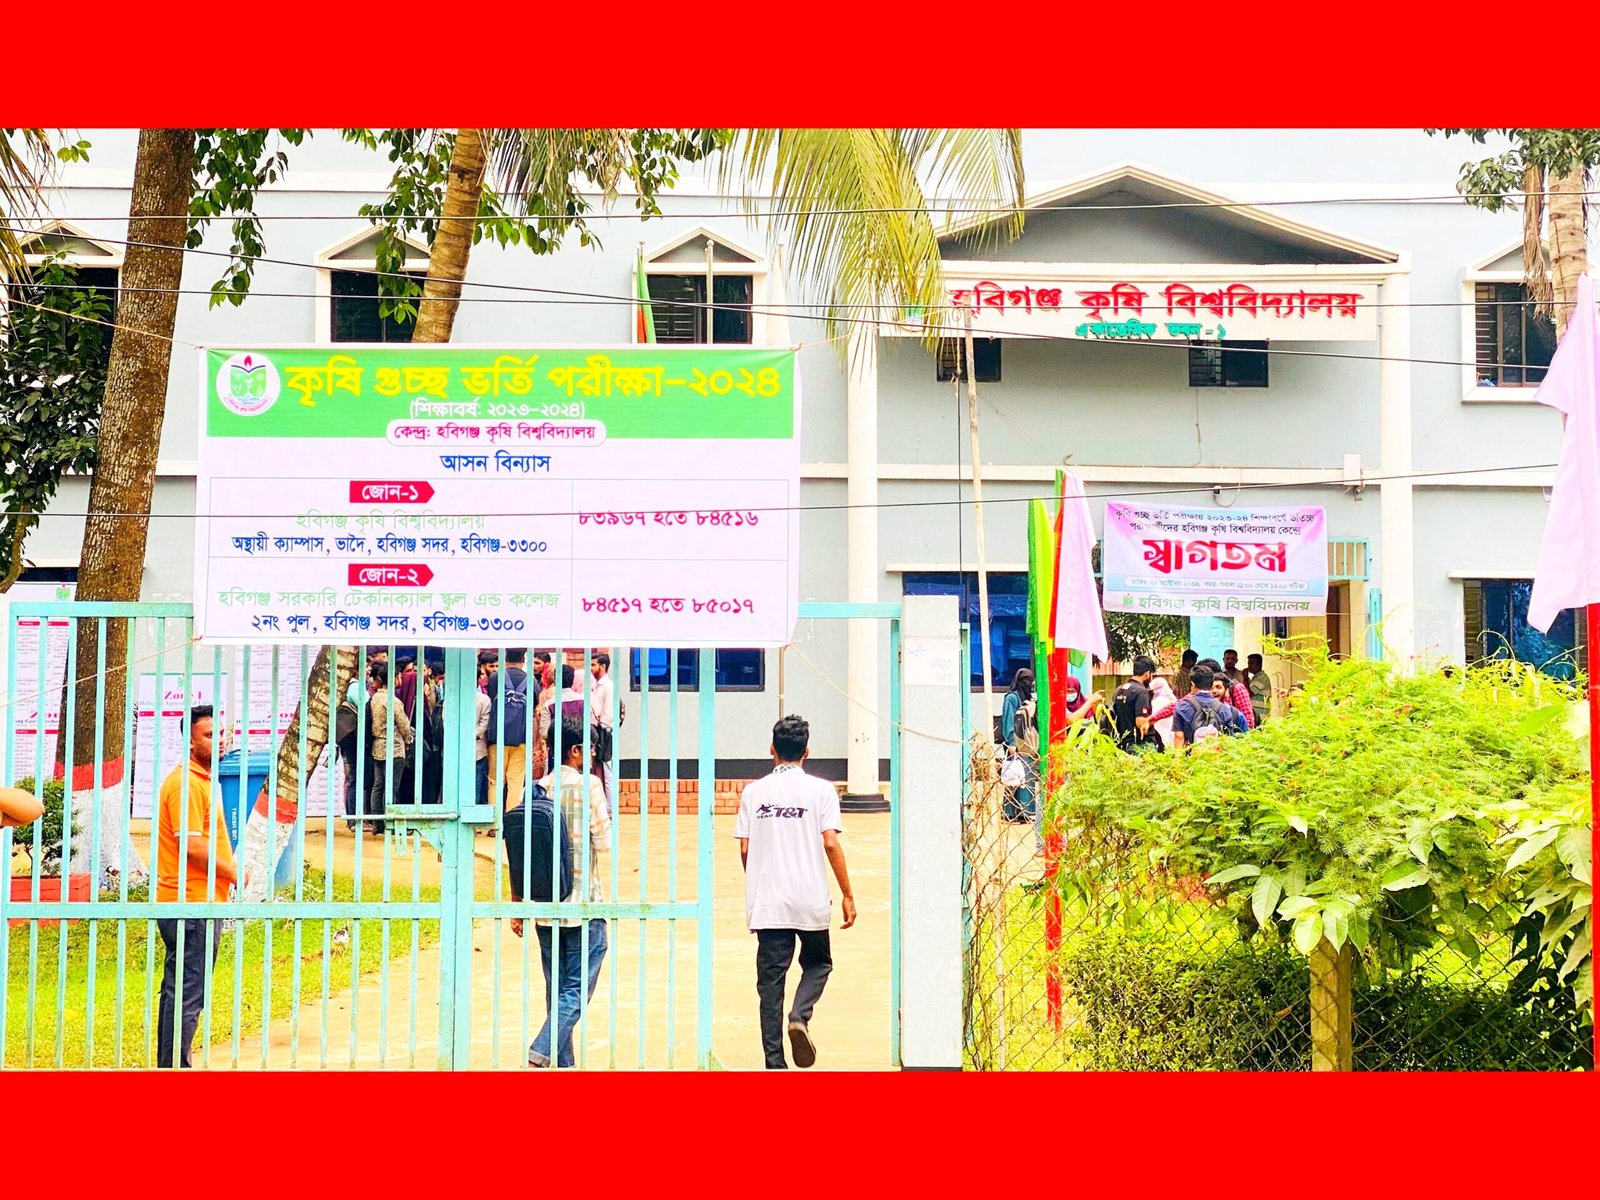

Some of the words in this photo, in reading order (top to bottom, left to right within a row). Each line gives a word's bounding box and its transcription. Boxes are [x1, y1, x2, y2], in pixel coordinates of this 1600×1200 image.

[1075, 282, 1149, 321] কৃষি
[1159, 283, 1364, 318] বিশ্ববিদ্যালয়
[284, 354, 364, 408] কৃষি
[374, 366, 450, 399] গুচ্ছ
[460, 354, 539, 396] ভর্তি
[548, 354, 780, 398] পরীক্ষা-২০২৪
[410, 398, 481, 419] (শিক্ষাবর্ষ:
[487, 400, 585, 419] ২০২৩-২০২৪)
[394, 425, 431, 440] কেন্দ্র:
[437, 423, 480, 440] হবিগঞ্জ
[486, 423, 511, 443] কৃষি
[518, 423, 595, 441] বিশ্ববিদ্যালয়
[440, 454, 488, 472] আসন
[495, 450, 551, 473] বিন্যাস
[362, 484, 419, 500] জোন-১
[296, 508, 348, 528] হবিগঞ্জ
[355, 509, 385, 534] কৃষি
[393, 509, 485, 531] বিশ্ববিদ্যালয়
[653, 510, 689, 526] হতে
[696, 511, 758, 526] ৮৪৫১৬
[1181, 522, 1208, 533] হবিগঞ্জ
[1211, 522, 1227, 536] কৃষি
[232, 531, 269, 554] অস্থায়ী
[274, 536, 330, 555] ক্যাম্পাস,
[335, 534, 371, 555] ভাদৈ,
[376, 532, 416, 552] হবিগঞ্জ
[421, 537, 455, 556] সদর,
[460, 533, 547, 553] হবিগঞ্জ-৩৩০০
[1142, 539, 1288, 574] স্বাগতম
[359, 567, 420, 585] জোন-২
[217, 586, 271, 606] হবিগঞ্জ
[277, 587, 338, 606] সরকারি
[344, 587, 434, 608] টেকনিক্যাল
[440, 592, 468, 611] স্কুল
[473, 592, 502, 608] এন্ড
[508, 593, 560, 609] কলেজ
[582, 598, 642, 613] ৮৪৫১৭
[648, 598, 686, 614] হতে
[692, 598, 754, 614] ৮৫০১৭
[1191, 596, 1221, 612] কৃষি
[1226, 596, 1310, 611] বিশ্ববিদ্যালয়
[252, 614, 280, 632] ২নং
[287, 614, 317, 633] পুল,
[323, 610, 371, 632] হবিগঞ্জ
[376, 616, 416, 635] সদর,
[422, 611, 525, 632] হবিগঞ্জ-৩৩০০
[774, 807, 808, 818] T&T
